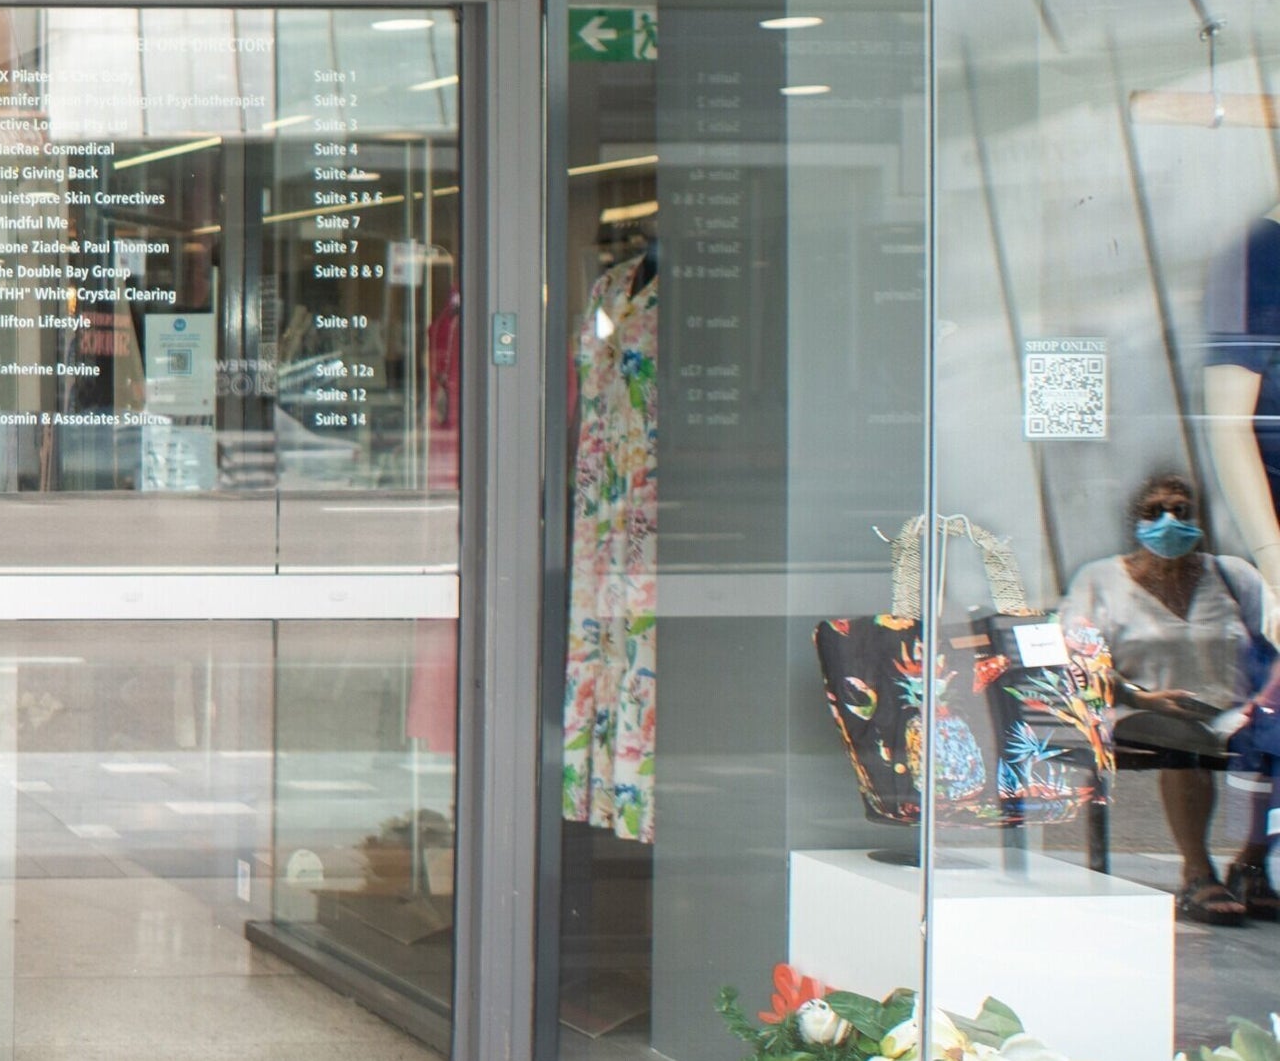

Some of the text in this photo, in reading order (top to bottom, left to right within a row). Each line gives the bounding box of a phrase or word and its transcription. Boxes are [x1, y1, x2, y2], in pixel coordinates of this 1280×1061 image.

[44, 143, 115, 155] Cosmedical
[22, 167, 65, 182] Giving
[68, 166, 98, 179] Back
[64, 192, 91, 204] Skin
[94, 192, 165, 204] Correctives
[47, 216, 68, 229] Me
[32, 241, 66, 254] Ziade
[69, 241, 80, 254] &
[84, 241, 110, 254] Paul
[113, 241, 170, 254] Thomson
[314, 240, 358, 253] Suite 7
[18, 265, 62, 277] Double
[66, 266, 89, 280] Bay
[93, 266, 131, 280] Group
[34, 288, 72, 300] White
[77, 288, 120, 303] Crystal
[124, 288, 177, 304] Clearing
[38, 316, 91, 331] Lifestyle
[316, 315, 367, 328] Suite 10
[1025, 341, 1107, 352] SHOP ONLINE
[57, 363, 100, 376] Devine
[42, 412, 51, 425] &
[54, 412, 120, 425] Associates
